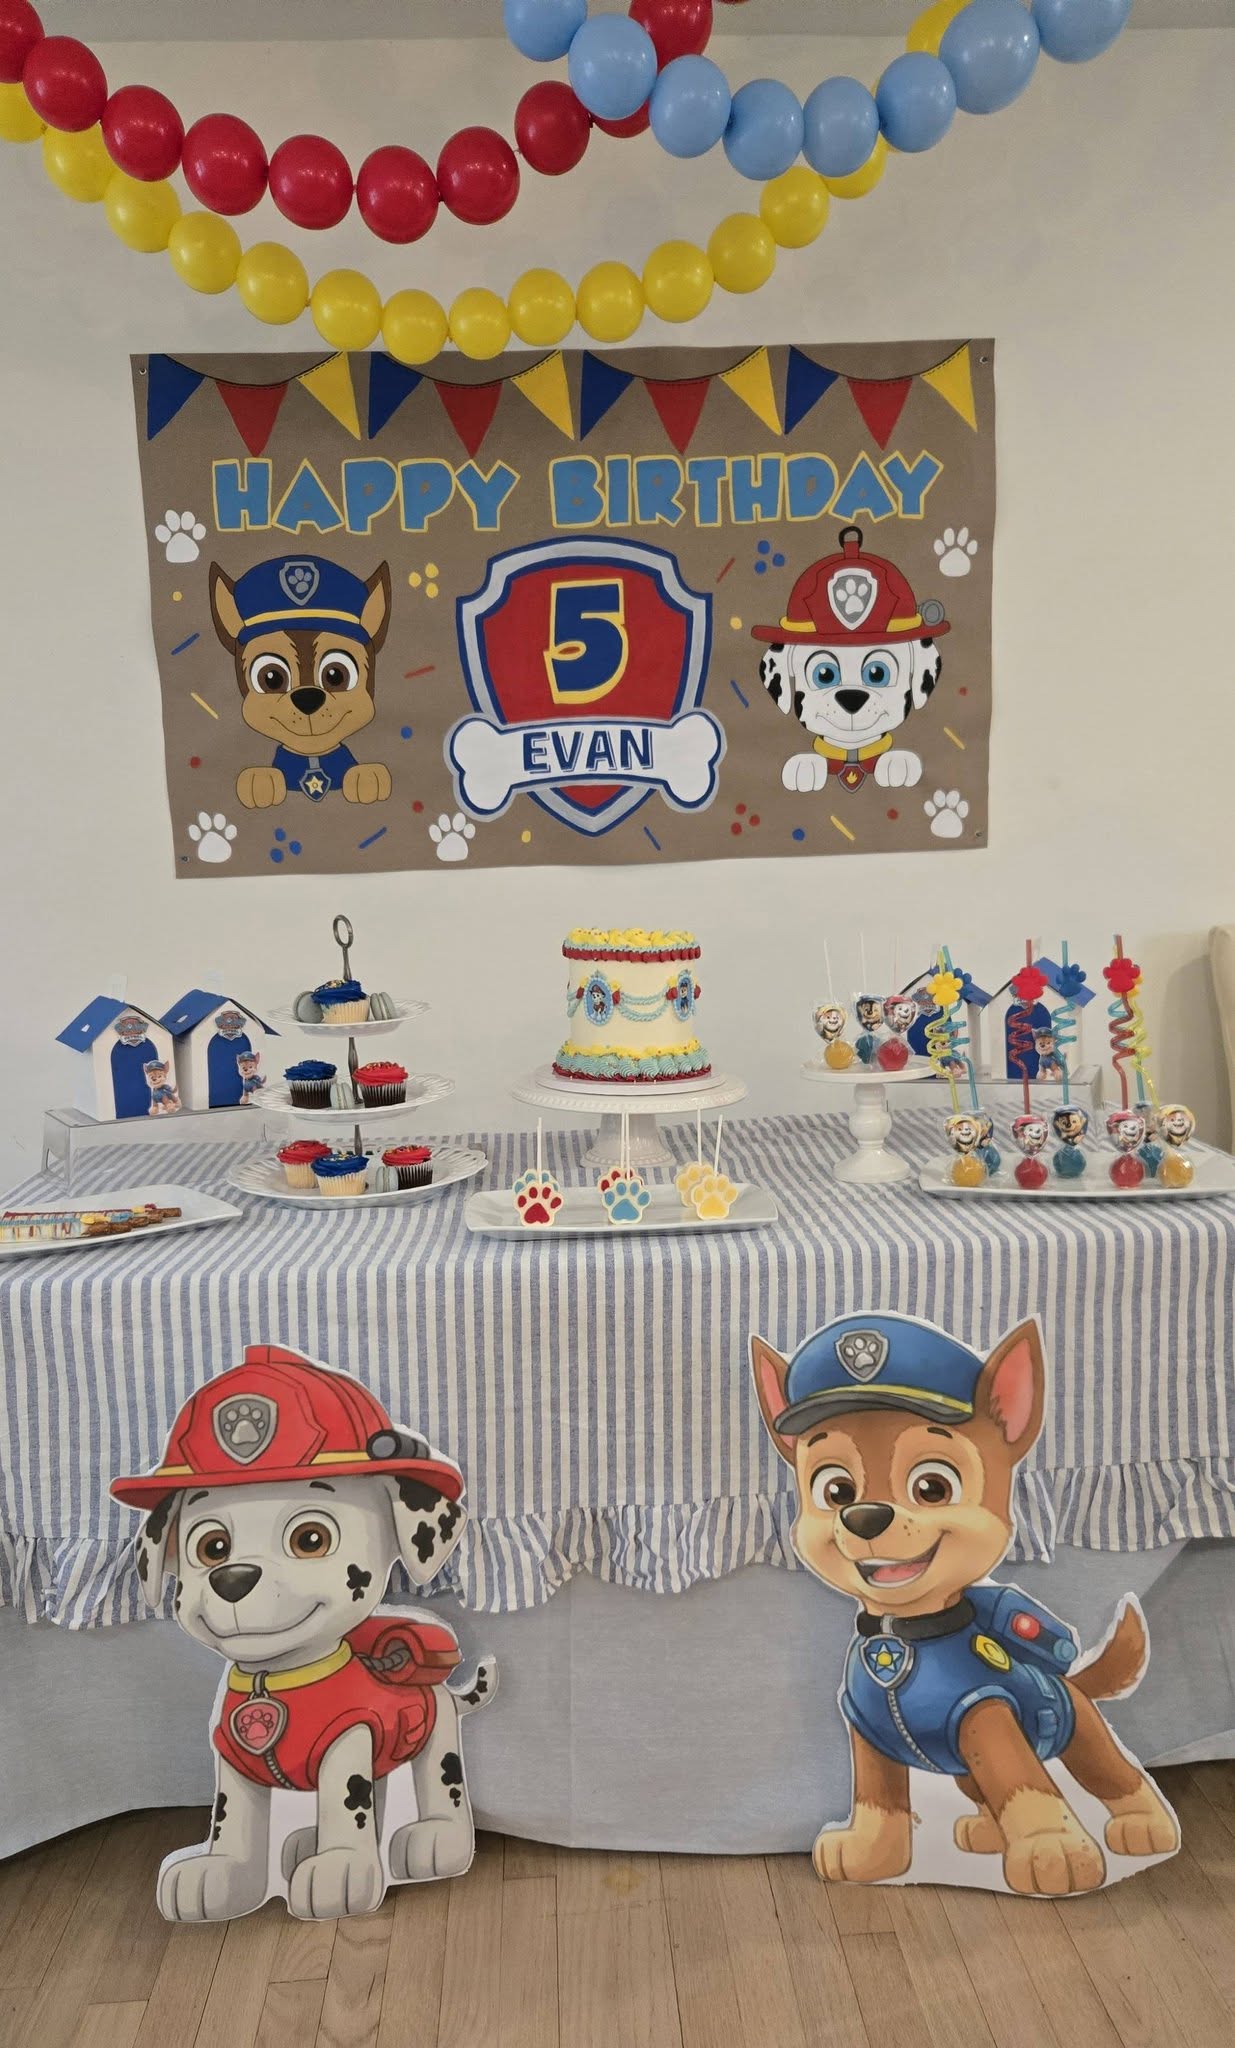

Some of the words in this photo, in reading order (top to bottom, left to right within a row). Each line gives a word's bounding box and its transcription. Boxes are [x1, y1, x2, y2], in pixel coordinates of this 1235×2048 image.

[212, 456, 521, 536] HAPPY
[548, 449, 945, 529] BIRTHDAY
[543, 577, 630, 705] 5
[522, 728, 654, 775] EVAN
